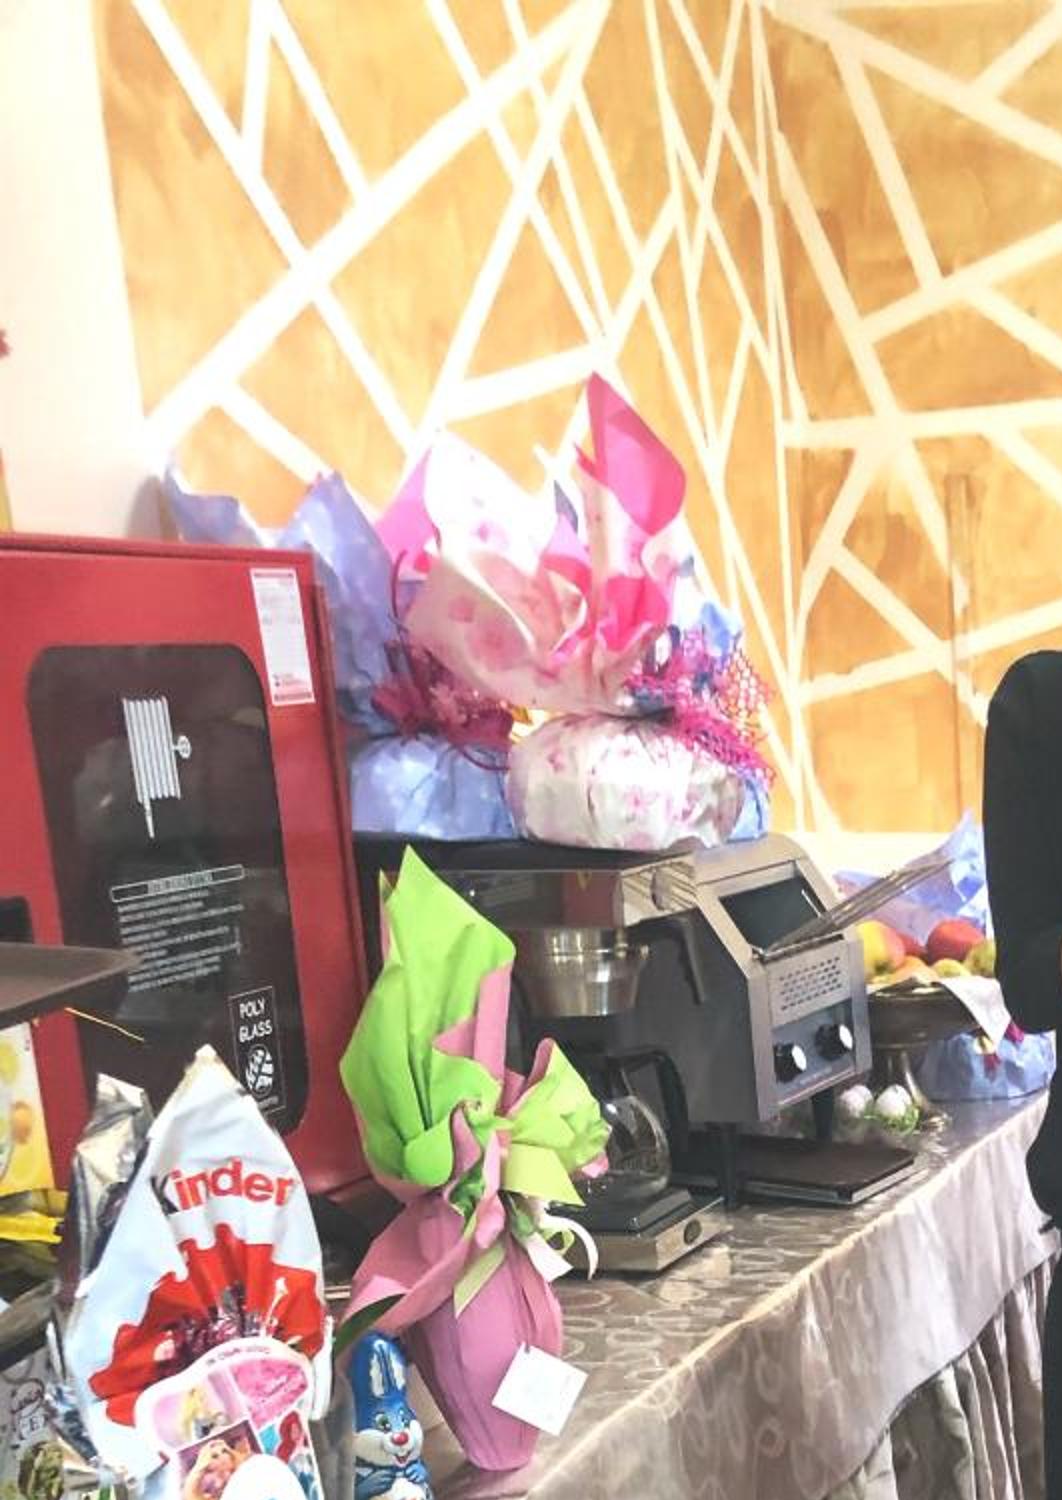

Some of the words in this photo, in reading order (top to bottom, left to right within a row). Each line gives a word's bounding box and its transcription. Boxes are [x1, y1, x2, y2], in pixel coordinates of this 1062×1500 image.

[239, 998, 266, 1018] POLY
[238, 1018, 273, 1043] GLASS
[151, 1156, 299, 1216] Kinder
